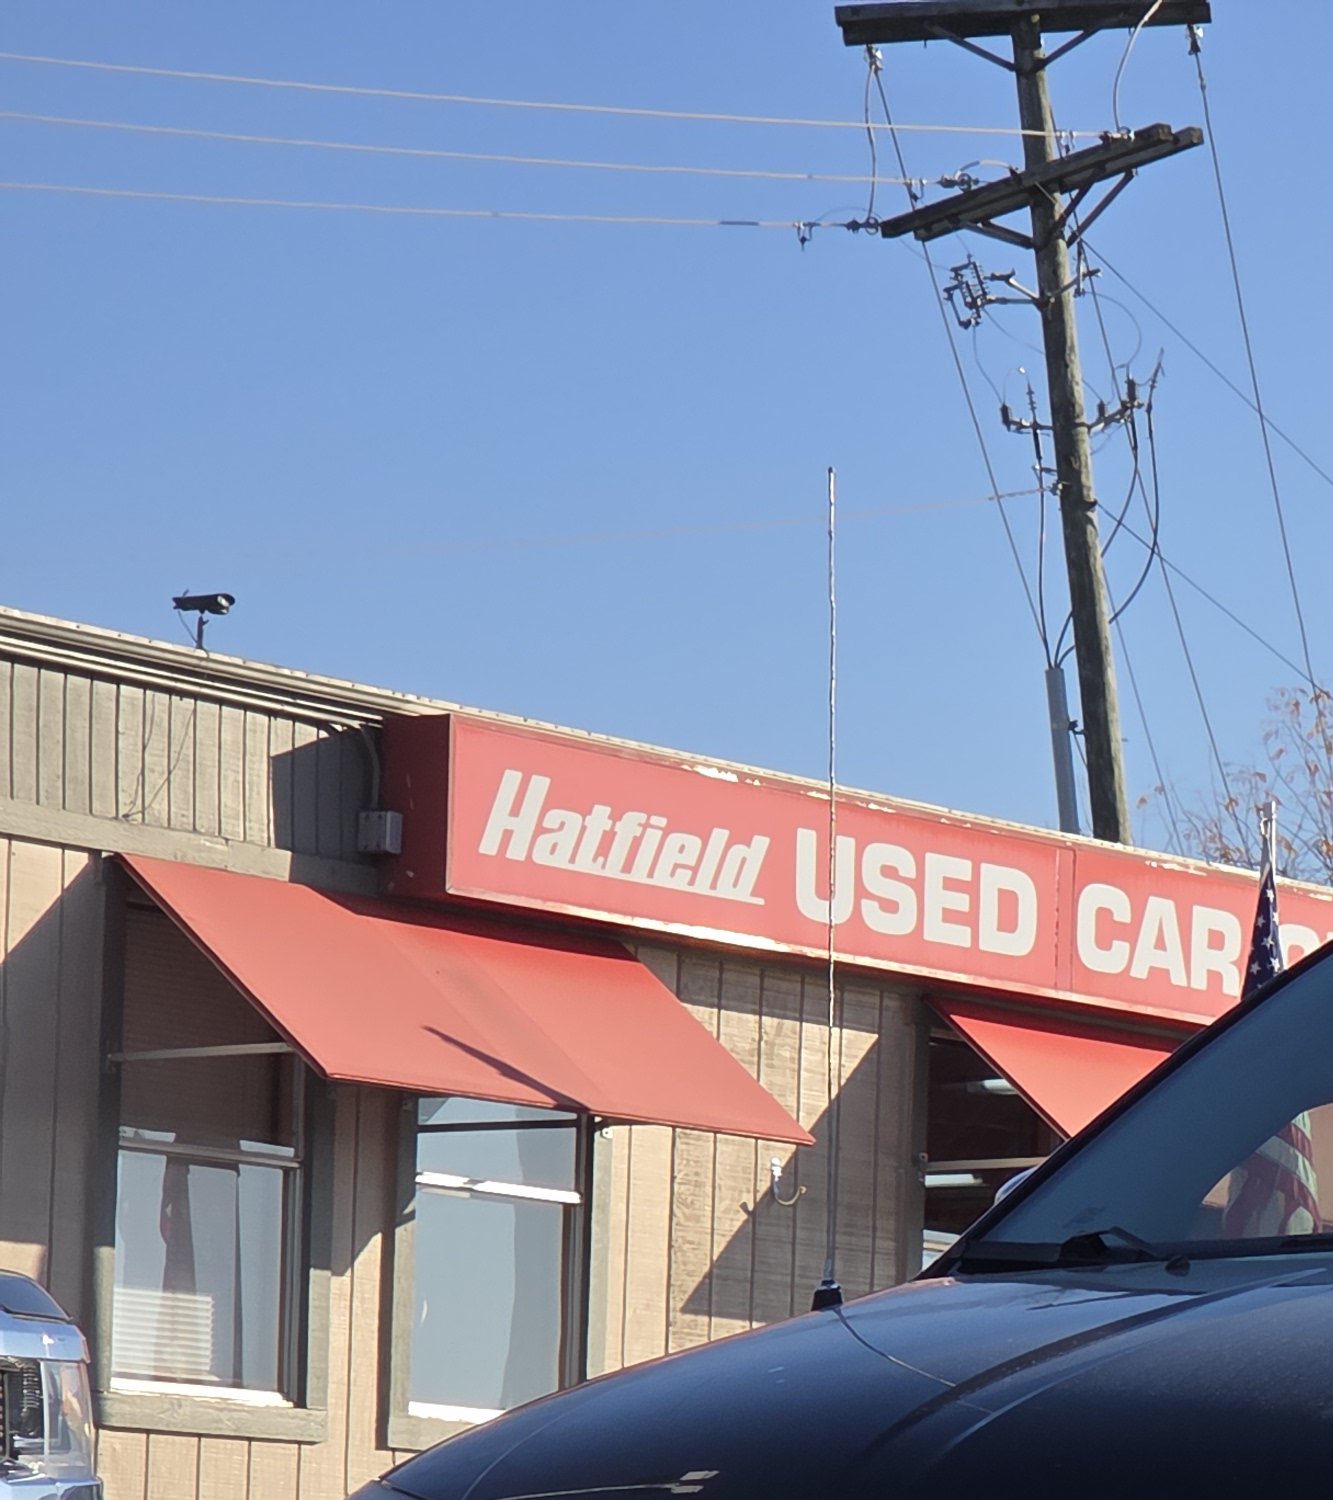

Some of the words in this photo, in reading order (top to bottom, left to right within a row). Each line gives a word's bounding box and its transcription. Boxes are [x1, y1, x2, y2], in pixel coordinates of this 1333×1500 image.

[478, 769, 770, 904] Hatfield
[796, 827, 1037, 956] USED
[1076, 883, 1241, 997] CAR
